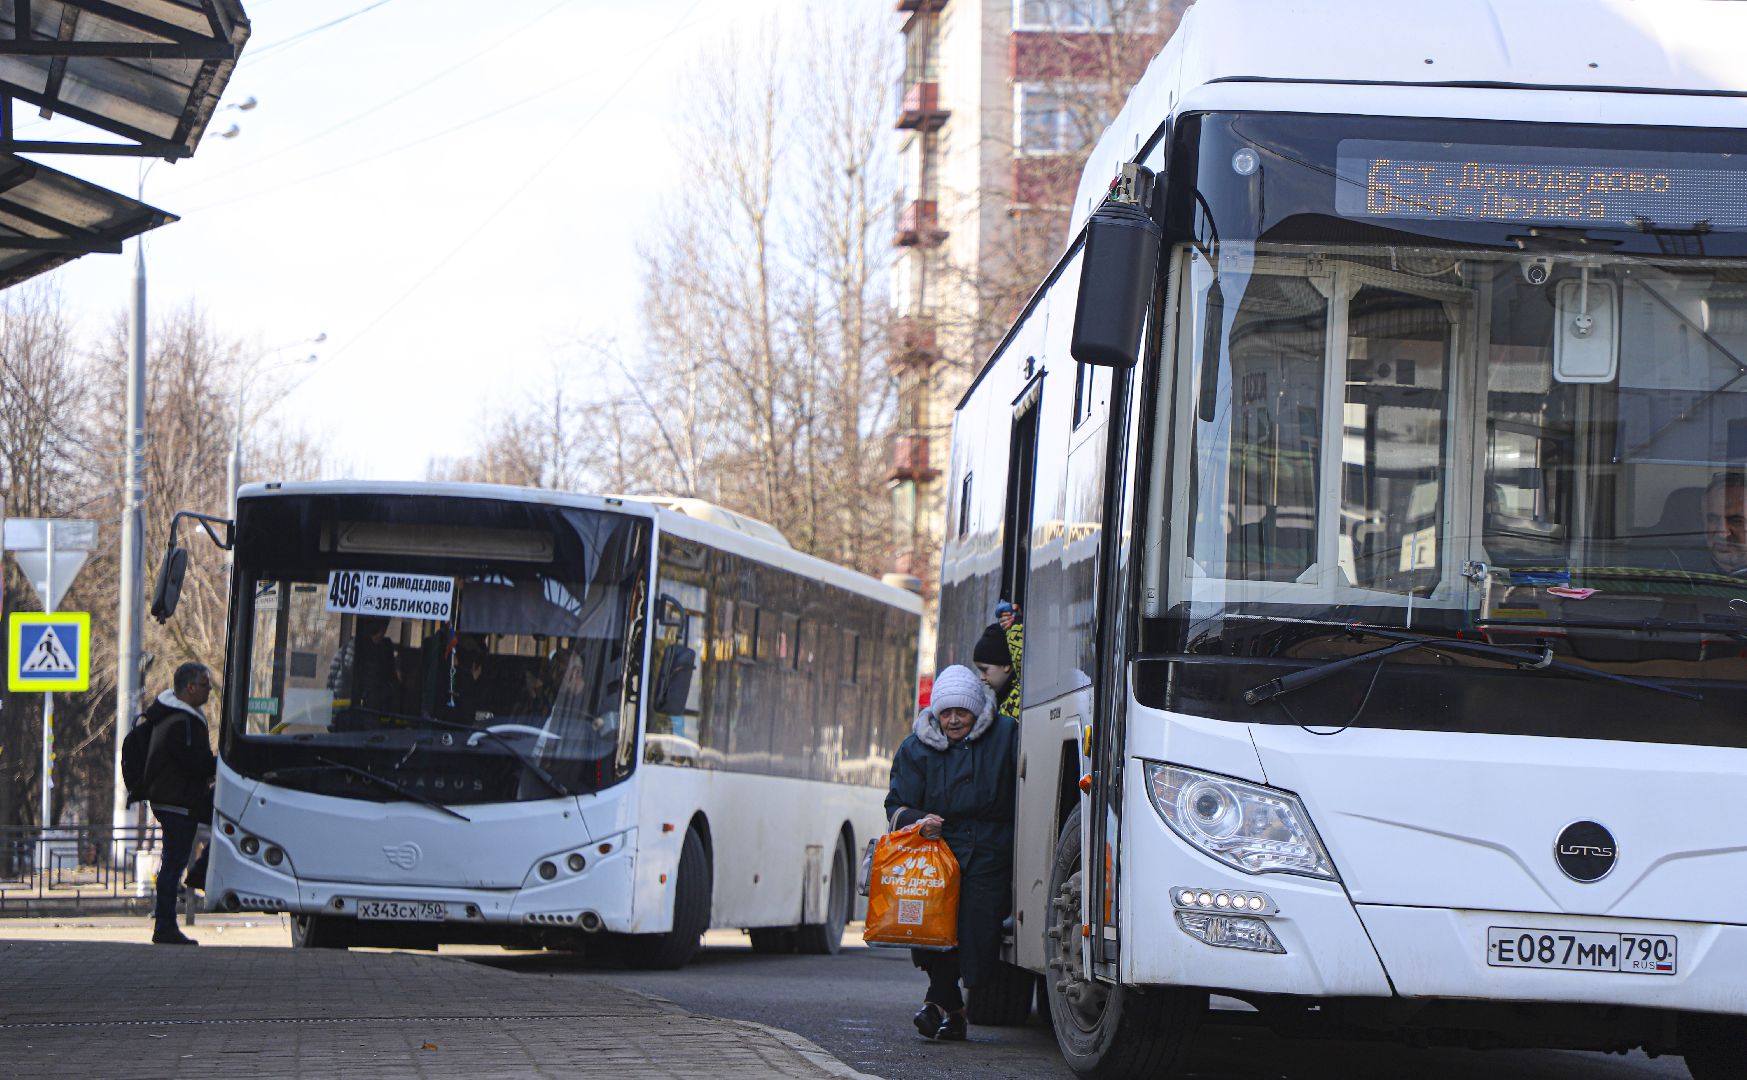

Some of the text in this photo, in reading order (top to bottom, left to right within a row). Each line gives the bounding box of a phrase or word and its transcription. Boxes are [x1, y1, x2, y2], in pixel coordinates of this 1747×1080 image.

[329, 572, 361, 608] 496
[366, 575, 451, 593] СТ. ДОМОДЕДОВО
[375, 597, 449, 616] ЗЯБЛИКОВО
[881, 875, 945, 888] КЛУБ ДРУЗЕЙ
[896, 886, 929, 896] ДИКСИ
[420, 903, 443, 914] 750
[1622, 937, 1668, 962] 790
[1632, 960, 1655, 970] RUS
